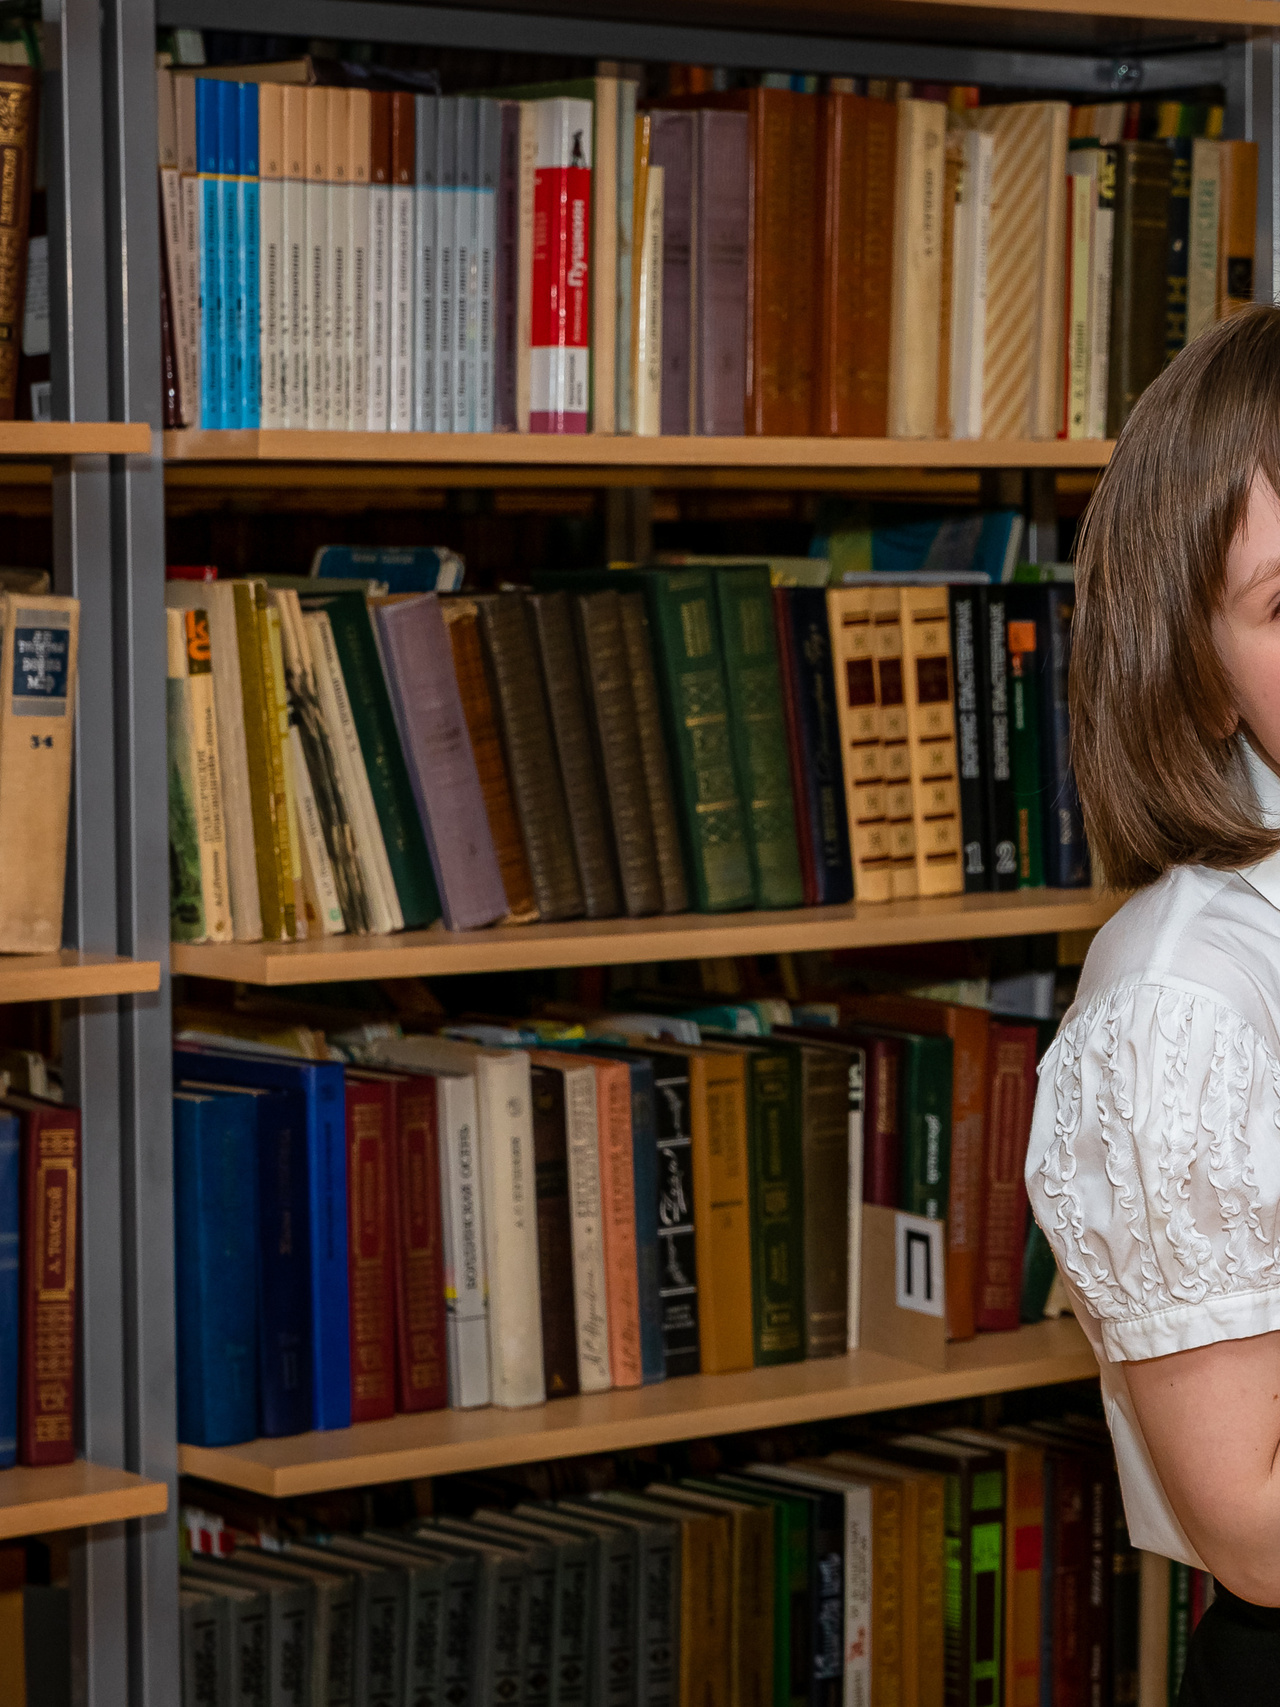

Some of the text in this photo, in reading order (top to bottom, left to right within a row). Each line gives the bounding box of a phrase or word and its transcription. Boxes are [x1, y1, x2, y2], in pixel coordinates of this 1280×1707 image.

[965, 842, 984, 874] 1
[995, 840, 1017, 874] 2
[905, 1230, 933, 1301] П
